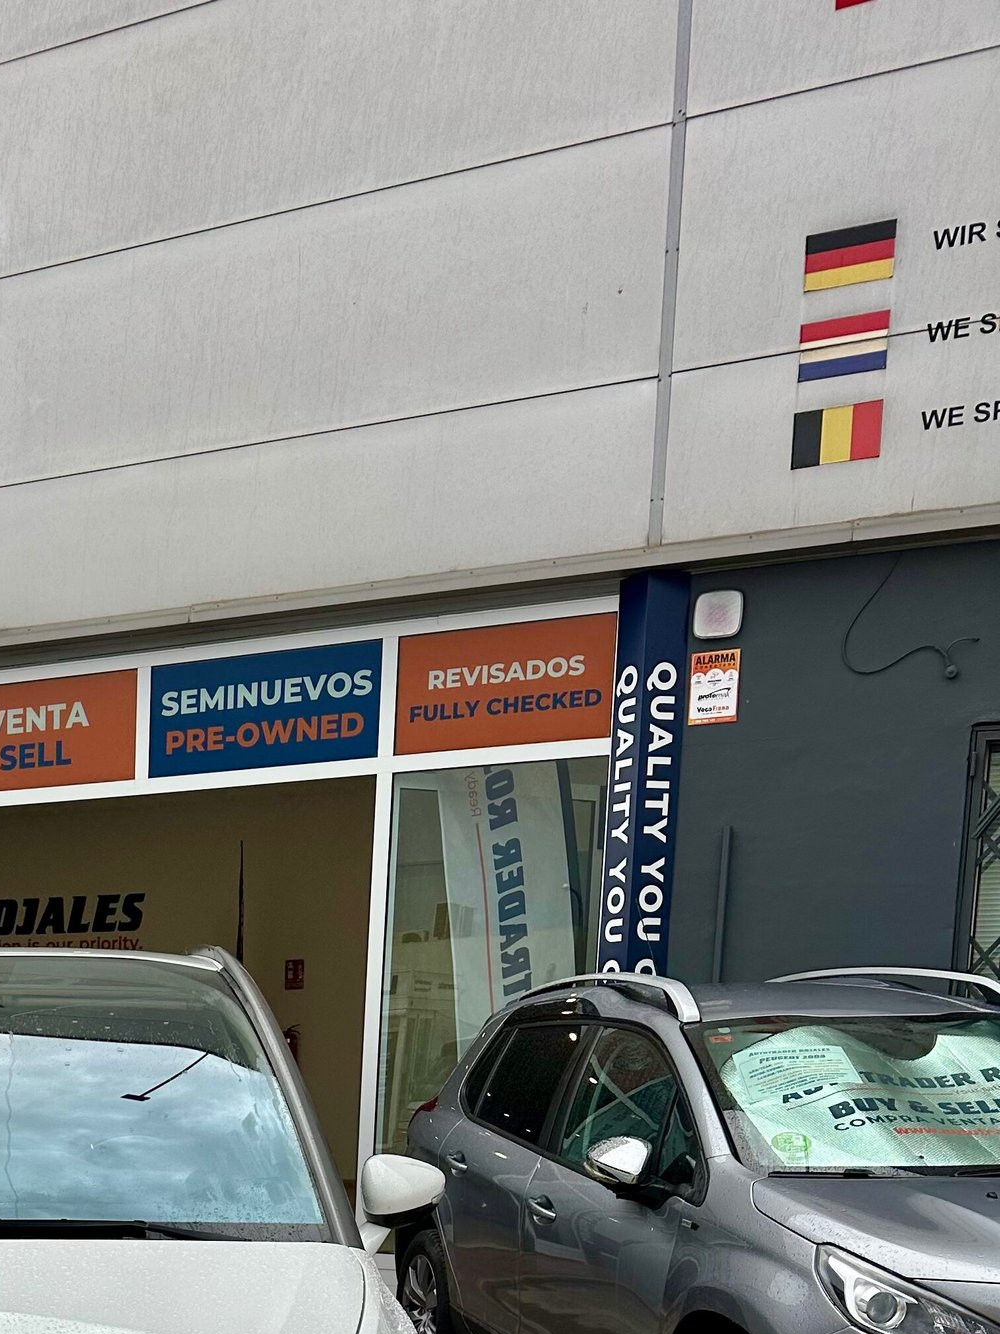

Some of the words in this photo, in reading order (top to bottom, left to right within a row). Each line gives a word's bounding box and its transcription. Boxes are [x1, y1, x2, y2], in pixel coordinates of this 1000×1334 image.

[933, 222, 987, 250] WIR
[927, 317, 971, 342] WE
[921, 405, 965, 430] WE
[428, 654, 585, 690] REVISADOS
[696, 653, 736, 665] ALARMA
[161, 669, 373, 717] SEMINUEVOS
[409, 699, 480, 723] FULLY
[486, 688, 602, 717] CHECKED
[165, 712, 364, 755] PRE-OWNED
[0, 740, 72, 771] SELL
[611, 665, 638, 844] QUALITY
[643, 661, 677, 843] QUALITY
[605, 857, 627, 942] YOU
[637, 857, 665, 941] YOU
[828, 1097, 898, 1119] BUY
[907, 1100, 934, 1114] &
[834, 1114, 929, 1131] COMPRA
